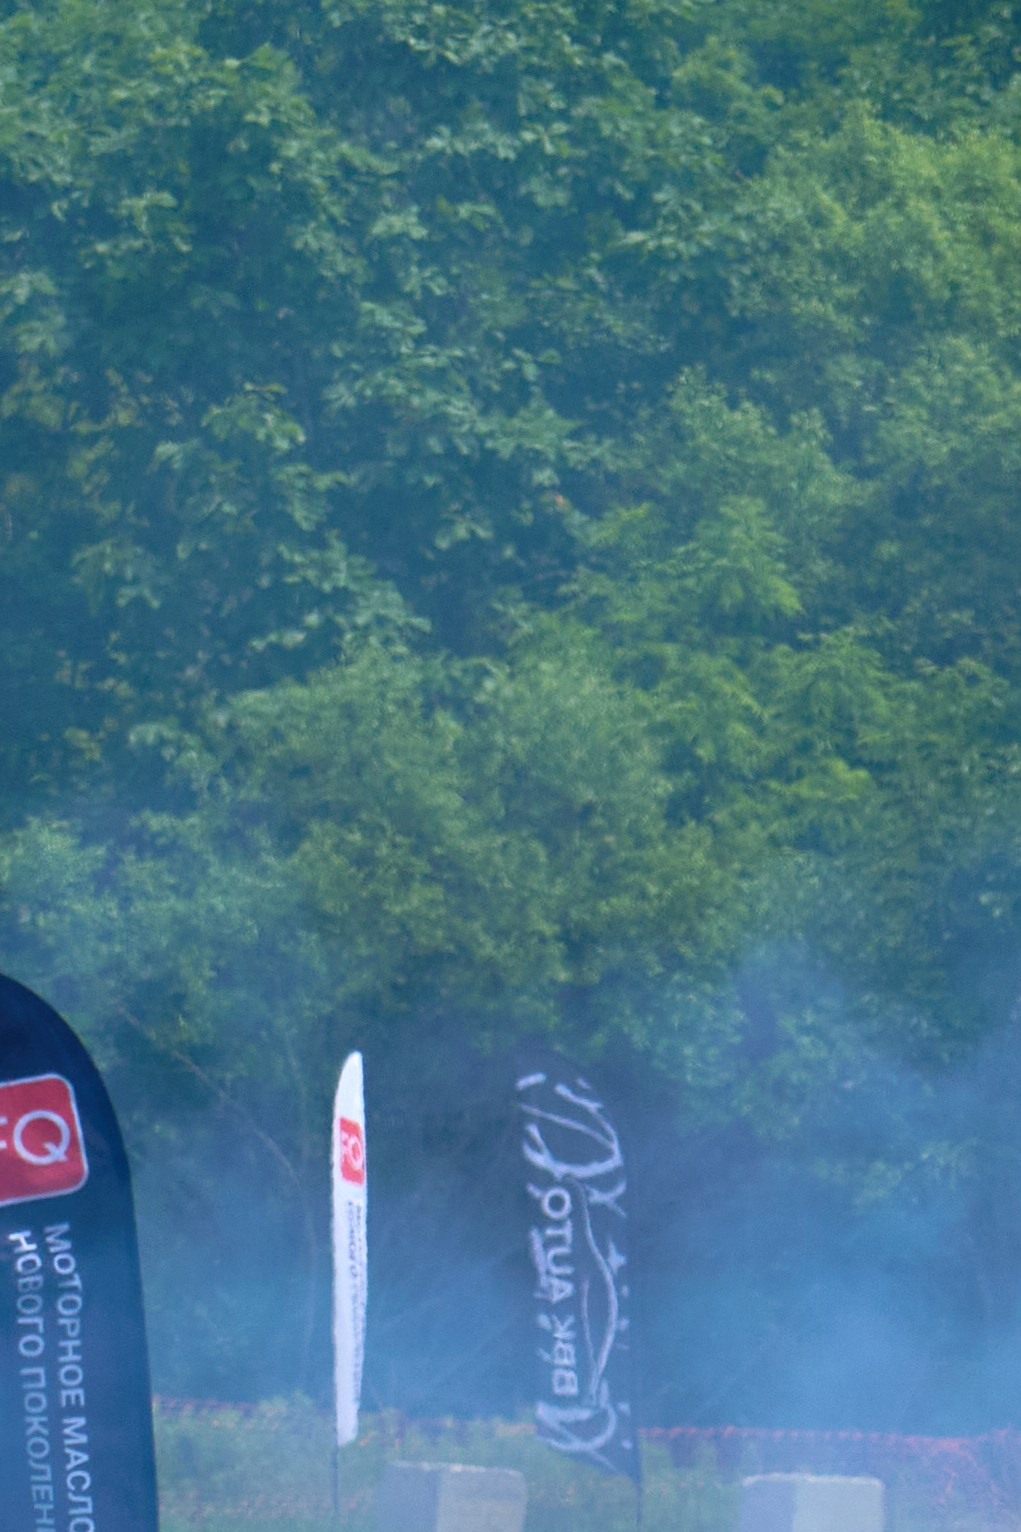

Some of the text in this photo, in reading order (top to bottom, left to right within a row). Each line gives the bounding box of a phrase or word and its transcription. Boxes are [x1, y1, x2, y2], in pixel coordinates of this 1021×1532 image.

[0, 1109, 71, 1166] Q
[7, 1230, 46, 1356] НОВОГО
[44, 1223, 86, 1407] МОТОРНОЕ
